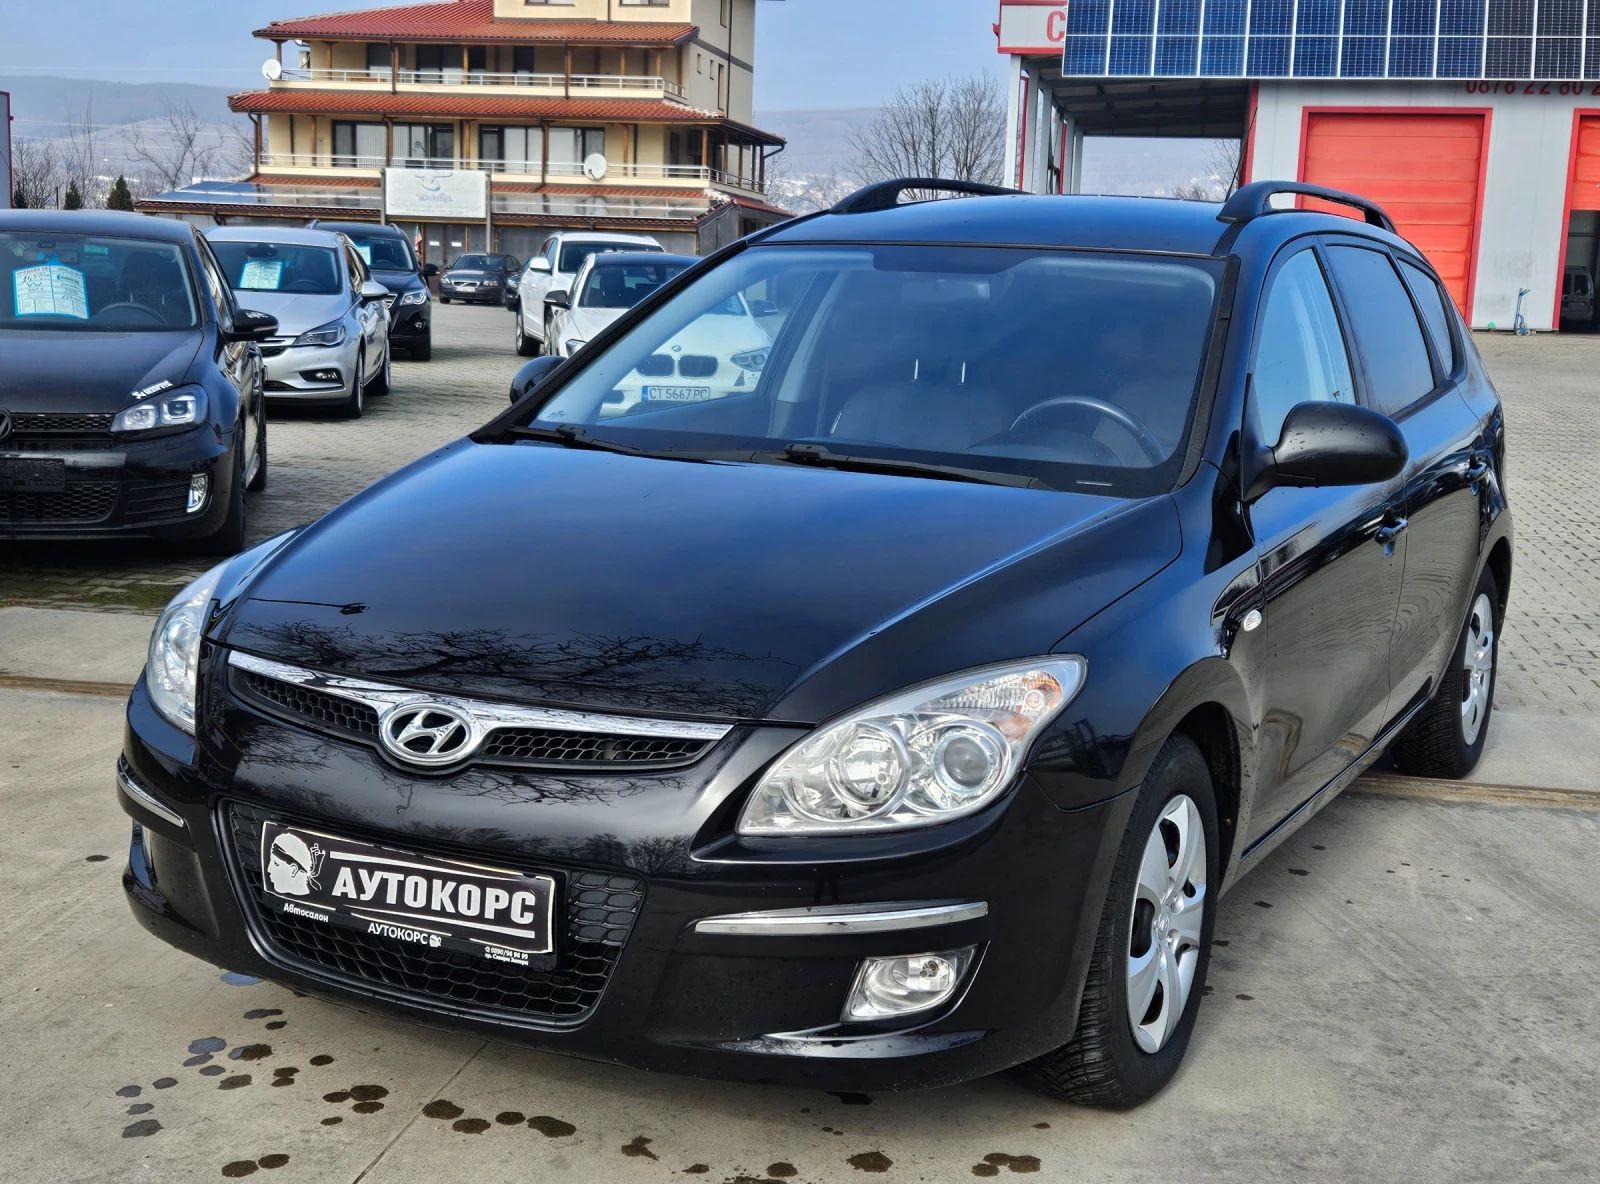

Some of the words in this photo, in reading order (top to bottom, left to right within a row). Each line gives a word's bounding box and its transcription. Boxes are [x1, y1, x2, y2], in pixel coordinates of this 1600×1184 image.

[665, 388, 692, 400] 5667
[331, 866, 536, 925] АУТОКОРС
[283, 902, 329, 923] Автосалон
[367, 922, 428, 945] АУТОКОРС
